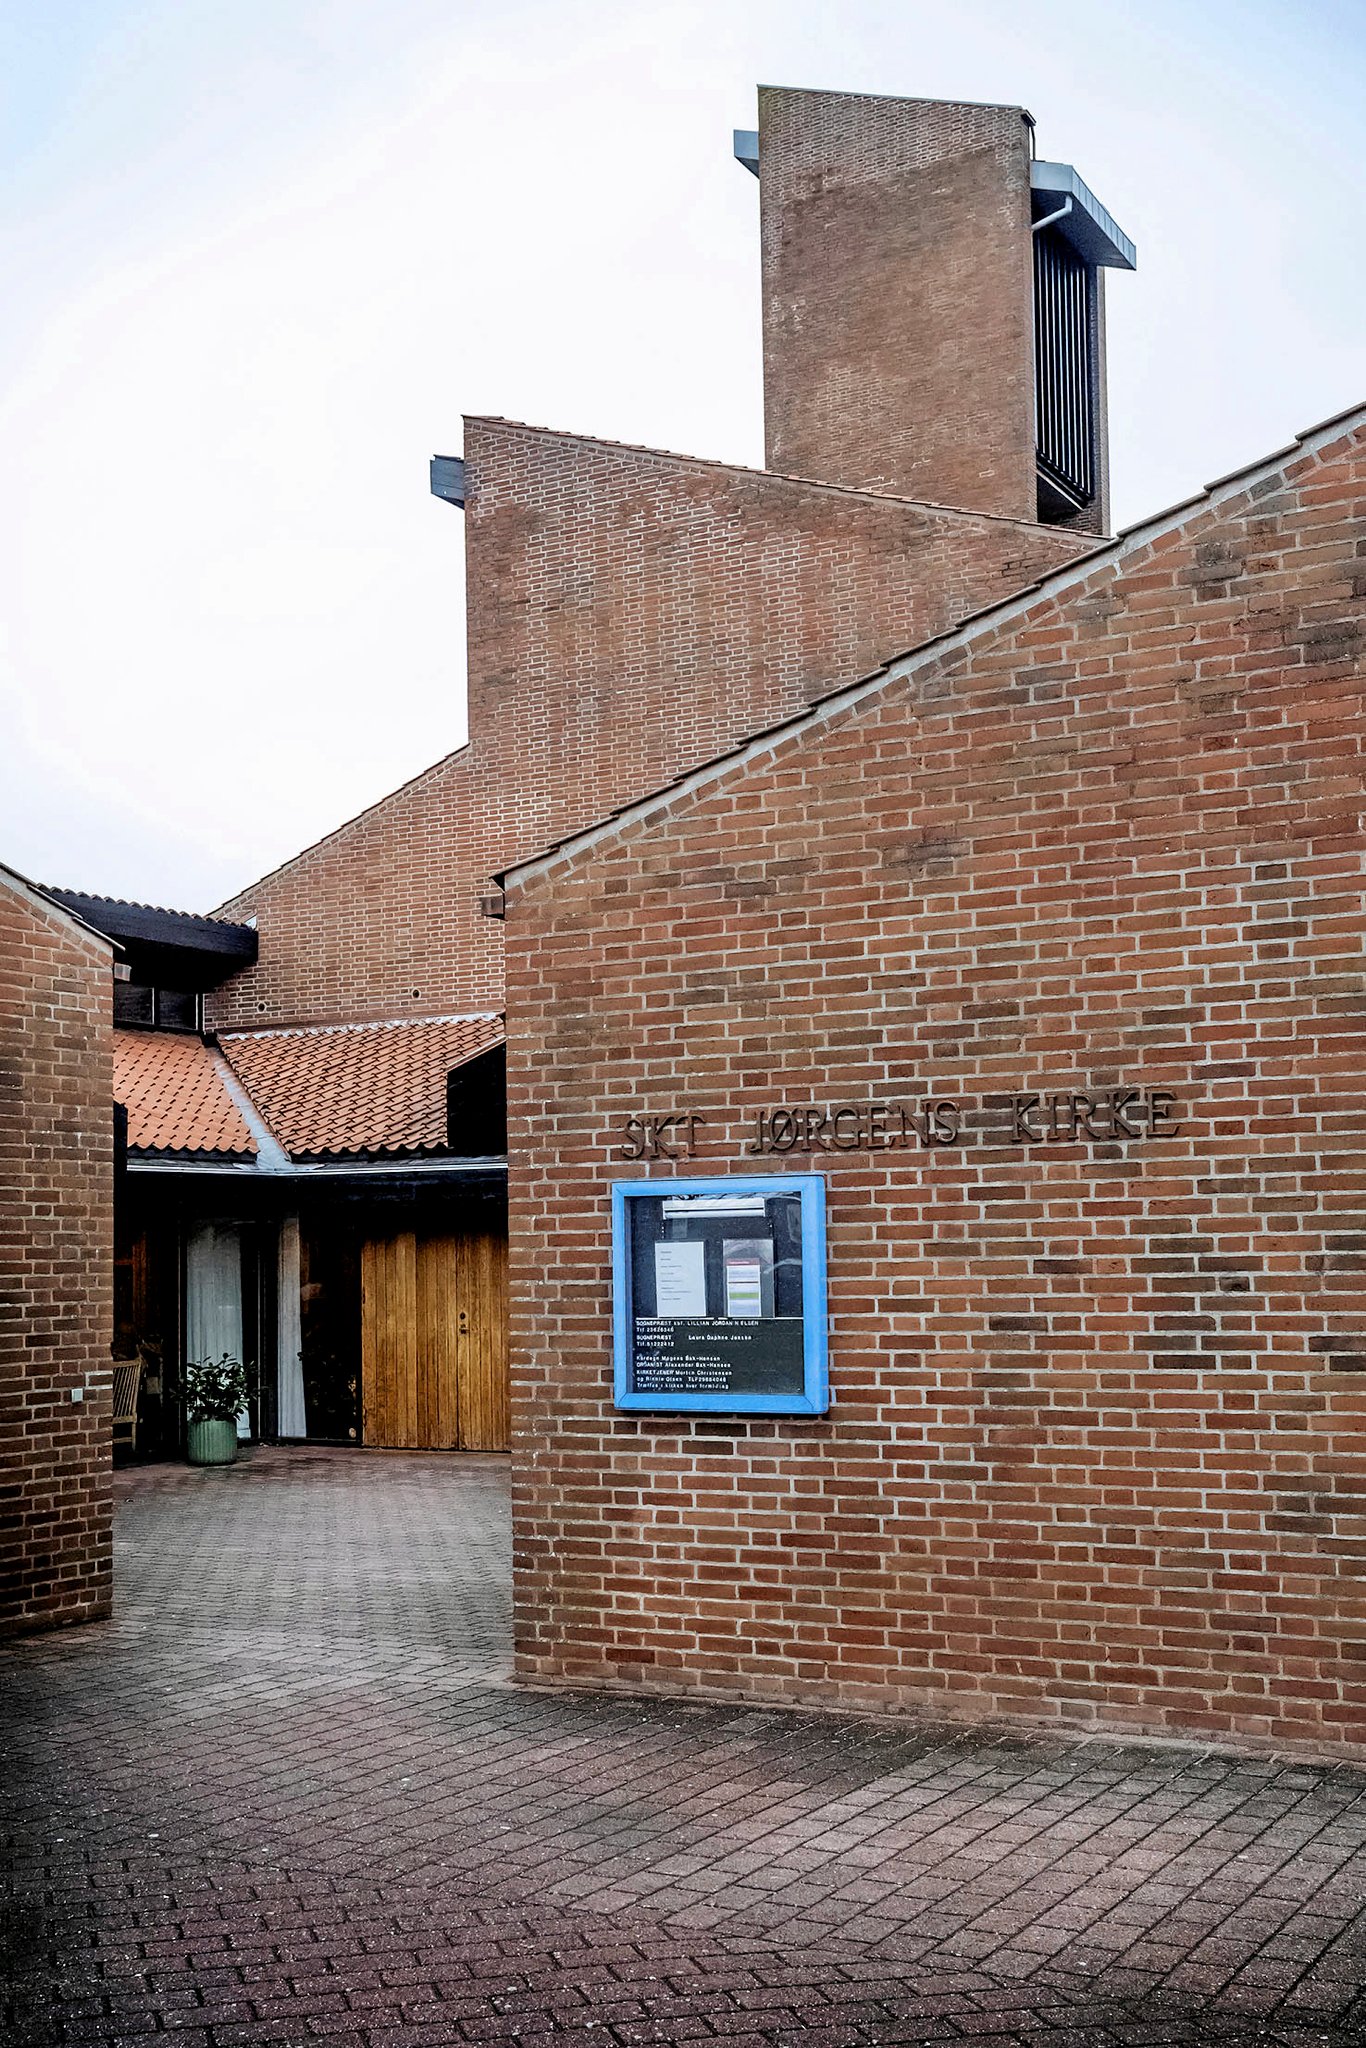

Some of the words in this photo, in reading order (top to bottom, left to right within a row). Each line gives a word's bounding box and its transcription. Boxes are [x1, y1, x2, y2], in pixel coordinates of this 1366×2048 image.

[621, 1113, 710, 1159] SKT
[749, 1099, 962, 1155] JØRGENS
[1008, 1088, 1182, 1142] KIRKE
